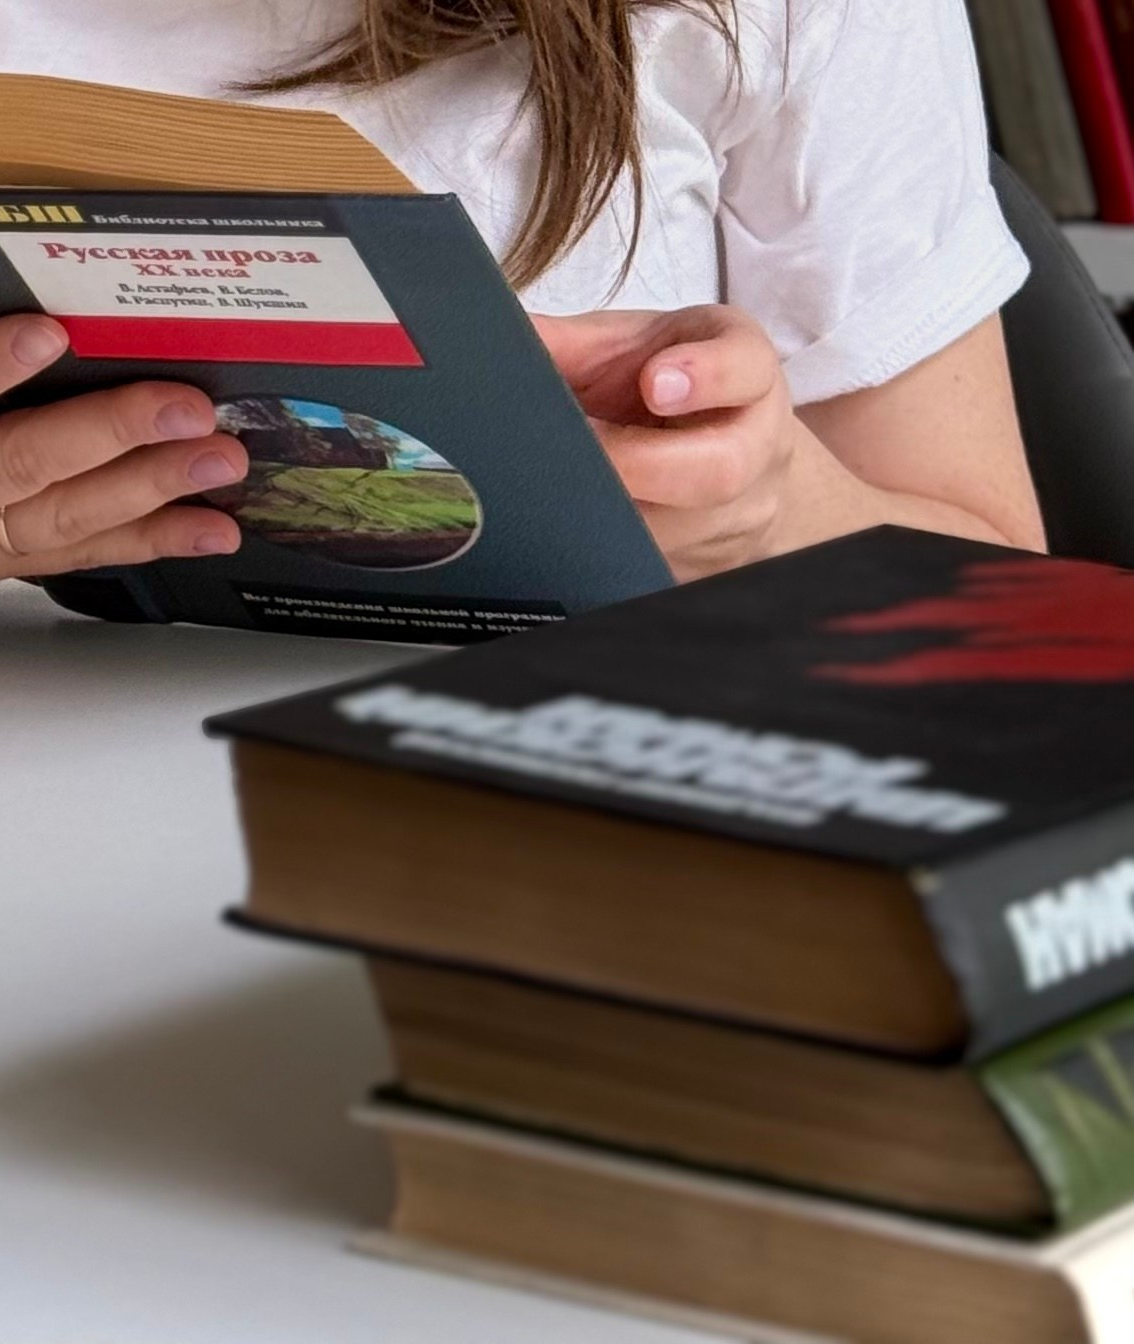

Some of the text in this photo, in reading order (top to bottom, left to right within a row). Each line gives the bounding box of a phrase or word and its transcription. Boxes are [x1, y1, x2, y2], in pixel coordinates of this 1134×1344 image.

[92, 213, 209, 227] Библиотека
[211, 217, 325, 229] школьника
[38, 242, 322, 267] Русская проза
[183, 267, 251, 279] века
[136, 283, 215, 296] Астафьев,
[234, 286, 290, 298] Белов,
[132, 295, 214, 308] Распутин,
[233, 298, 309, 310] Шукшин
